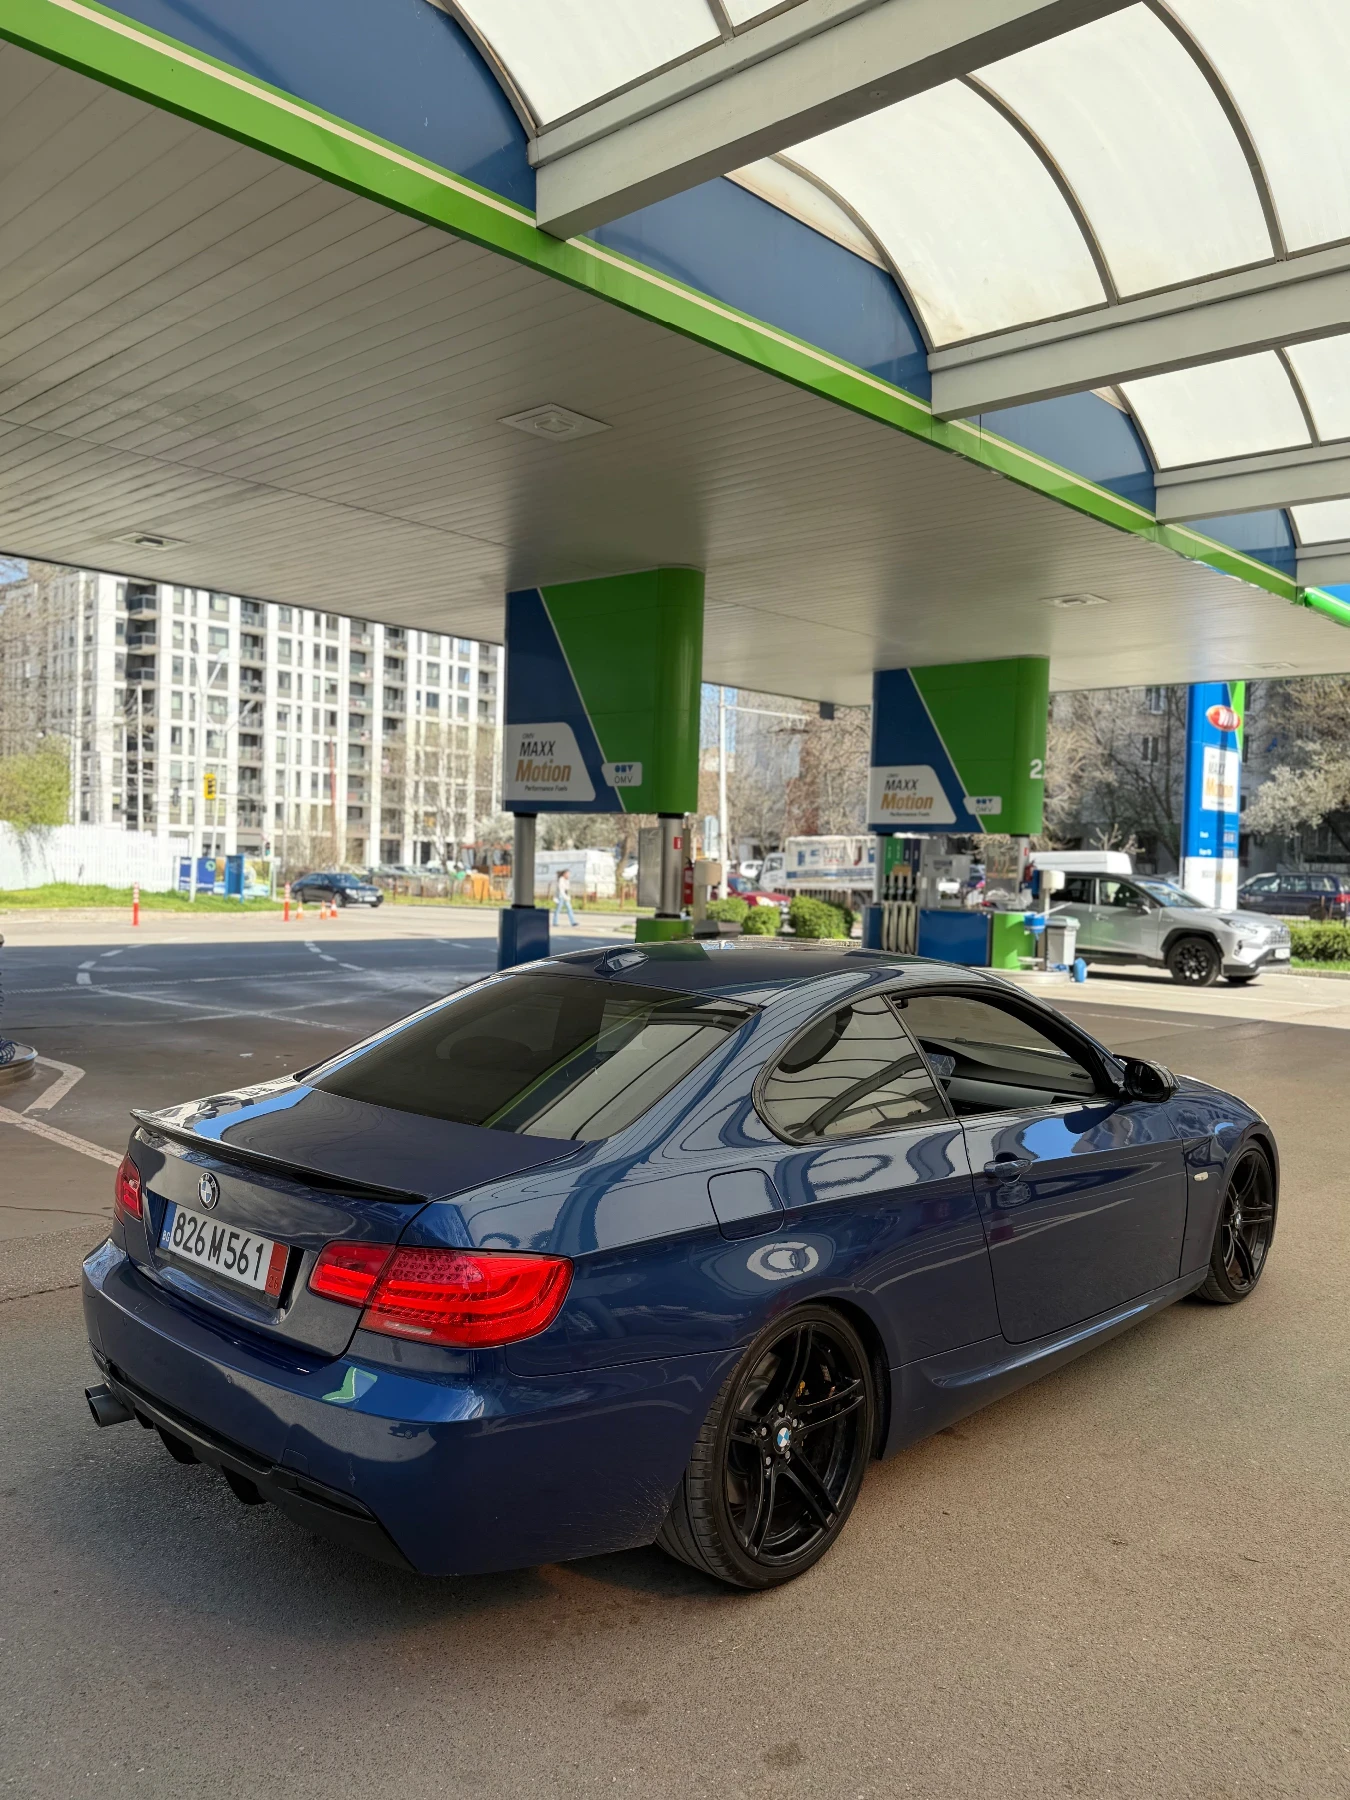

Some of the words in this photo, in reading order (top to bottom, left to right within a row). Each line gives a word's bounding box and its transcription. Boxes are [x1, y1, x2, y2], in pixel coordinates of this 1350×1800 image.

[519, 740, 556, 757] MAXX
[514, 758, 572, 783] Motion
[614, 775, 633, 784] OMV
[884, 778, 919, 791] MAXX
[880, 792, 934, 810] Motion
[162, 1230, 171, 1242] BG
